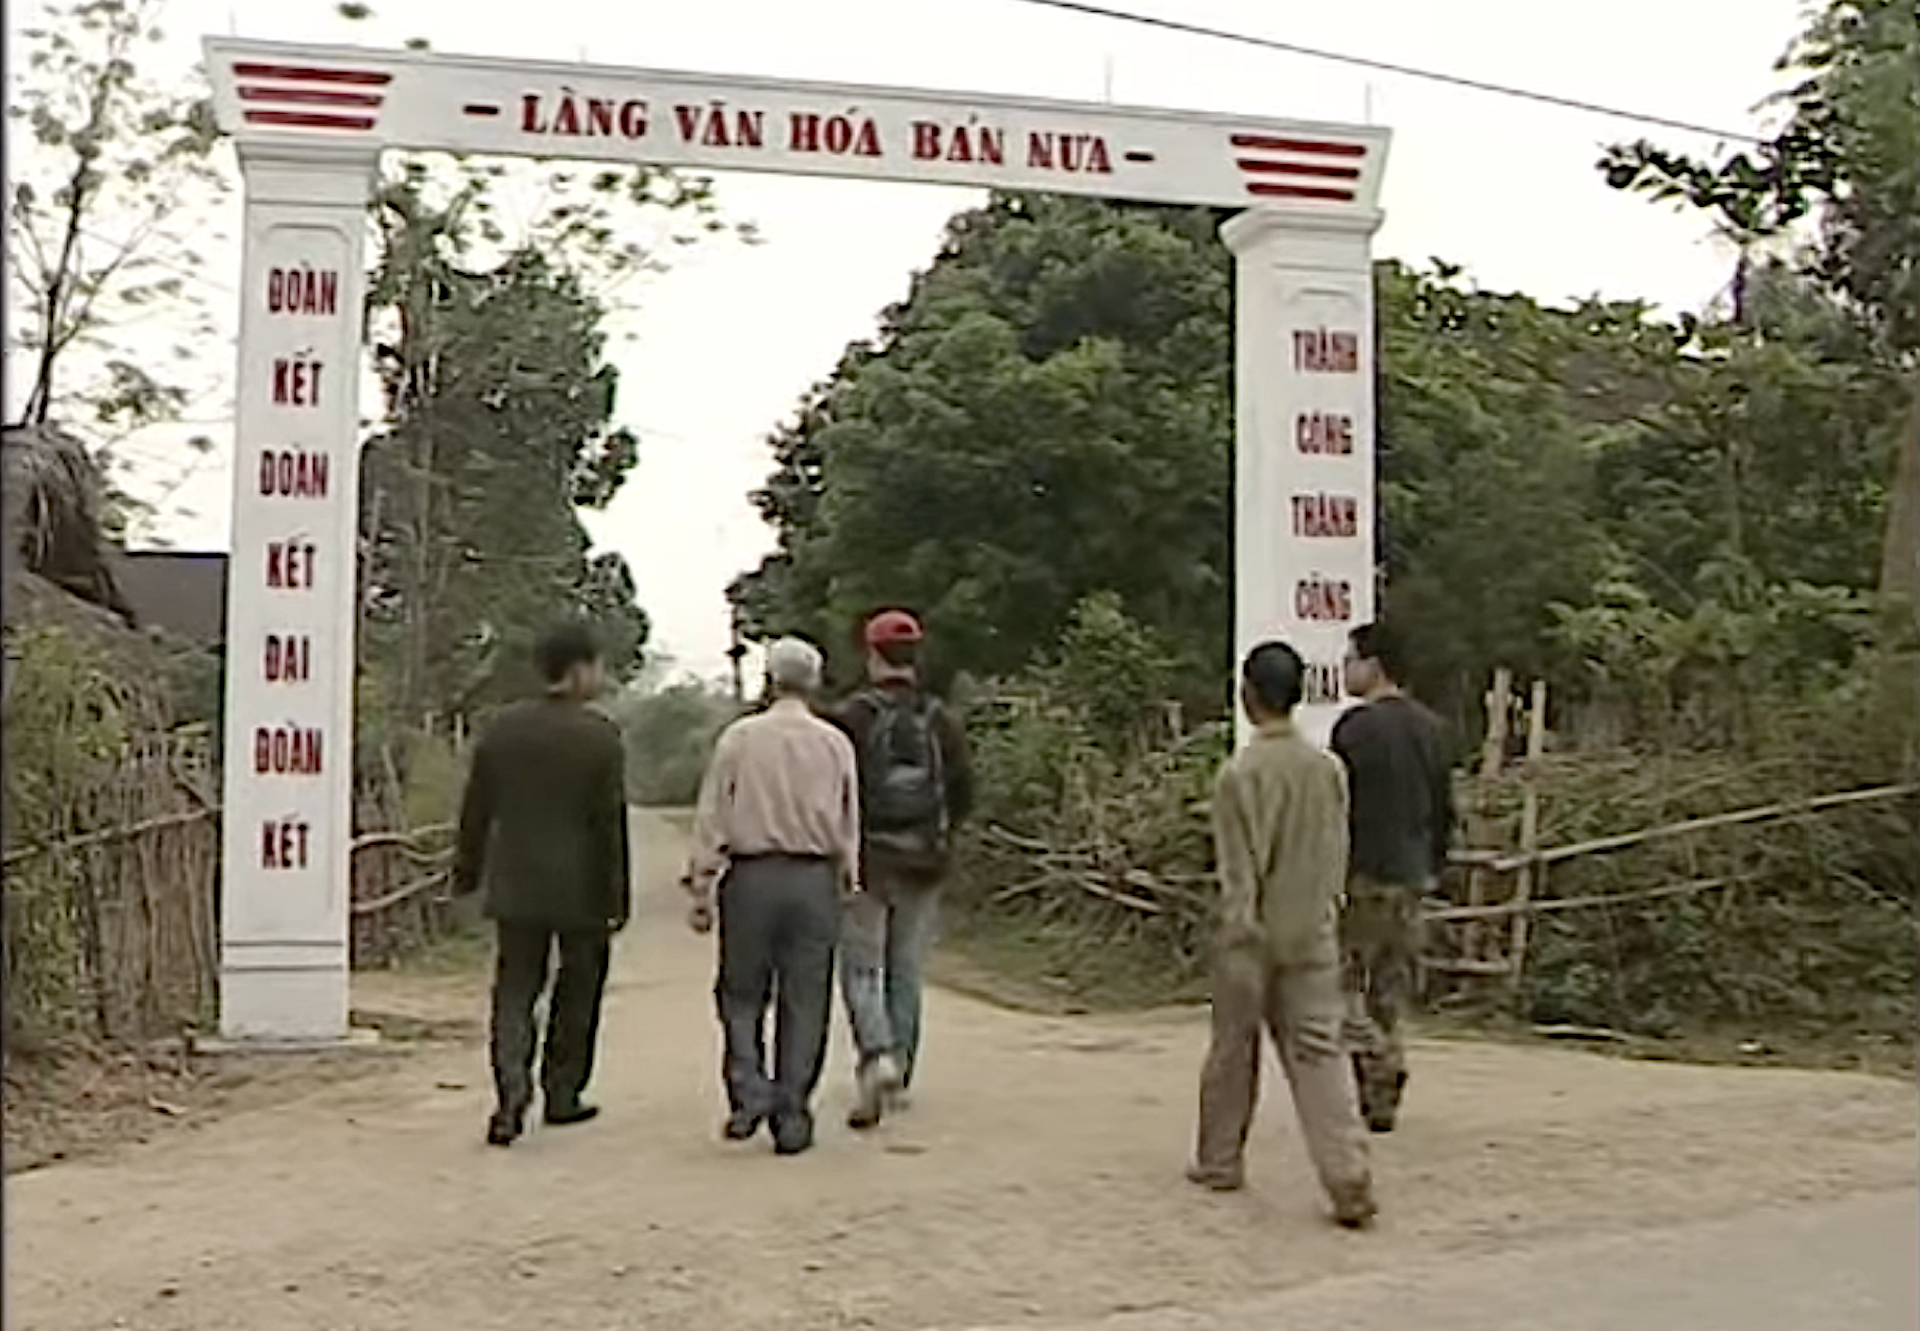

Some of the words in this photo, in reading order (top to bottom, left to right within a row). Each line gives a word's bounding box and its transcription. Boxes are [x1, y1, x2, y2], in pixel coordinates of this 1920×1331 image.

[521, 87, 648, 138] LÀNG
[674, 100, 763, 146] VĂN
[789, 107, 882, 156] HÓA
[268, 260, 338, 315] ĐOÀN
[272, 346, 323, 406] KẾT
[255, 720, 322, 774] ĐOÀN
